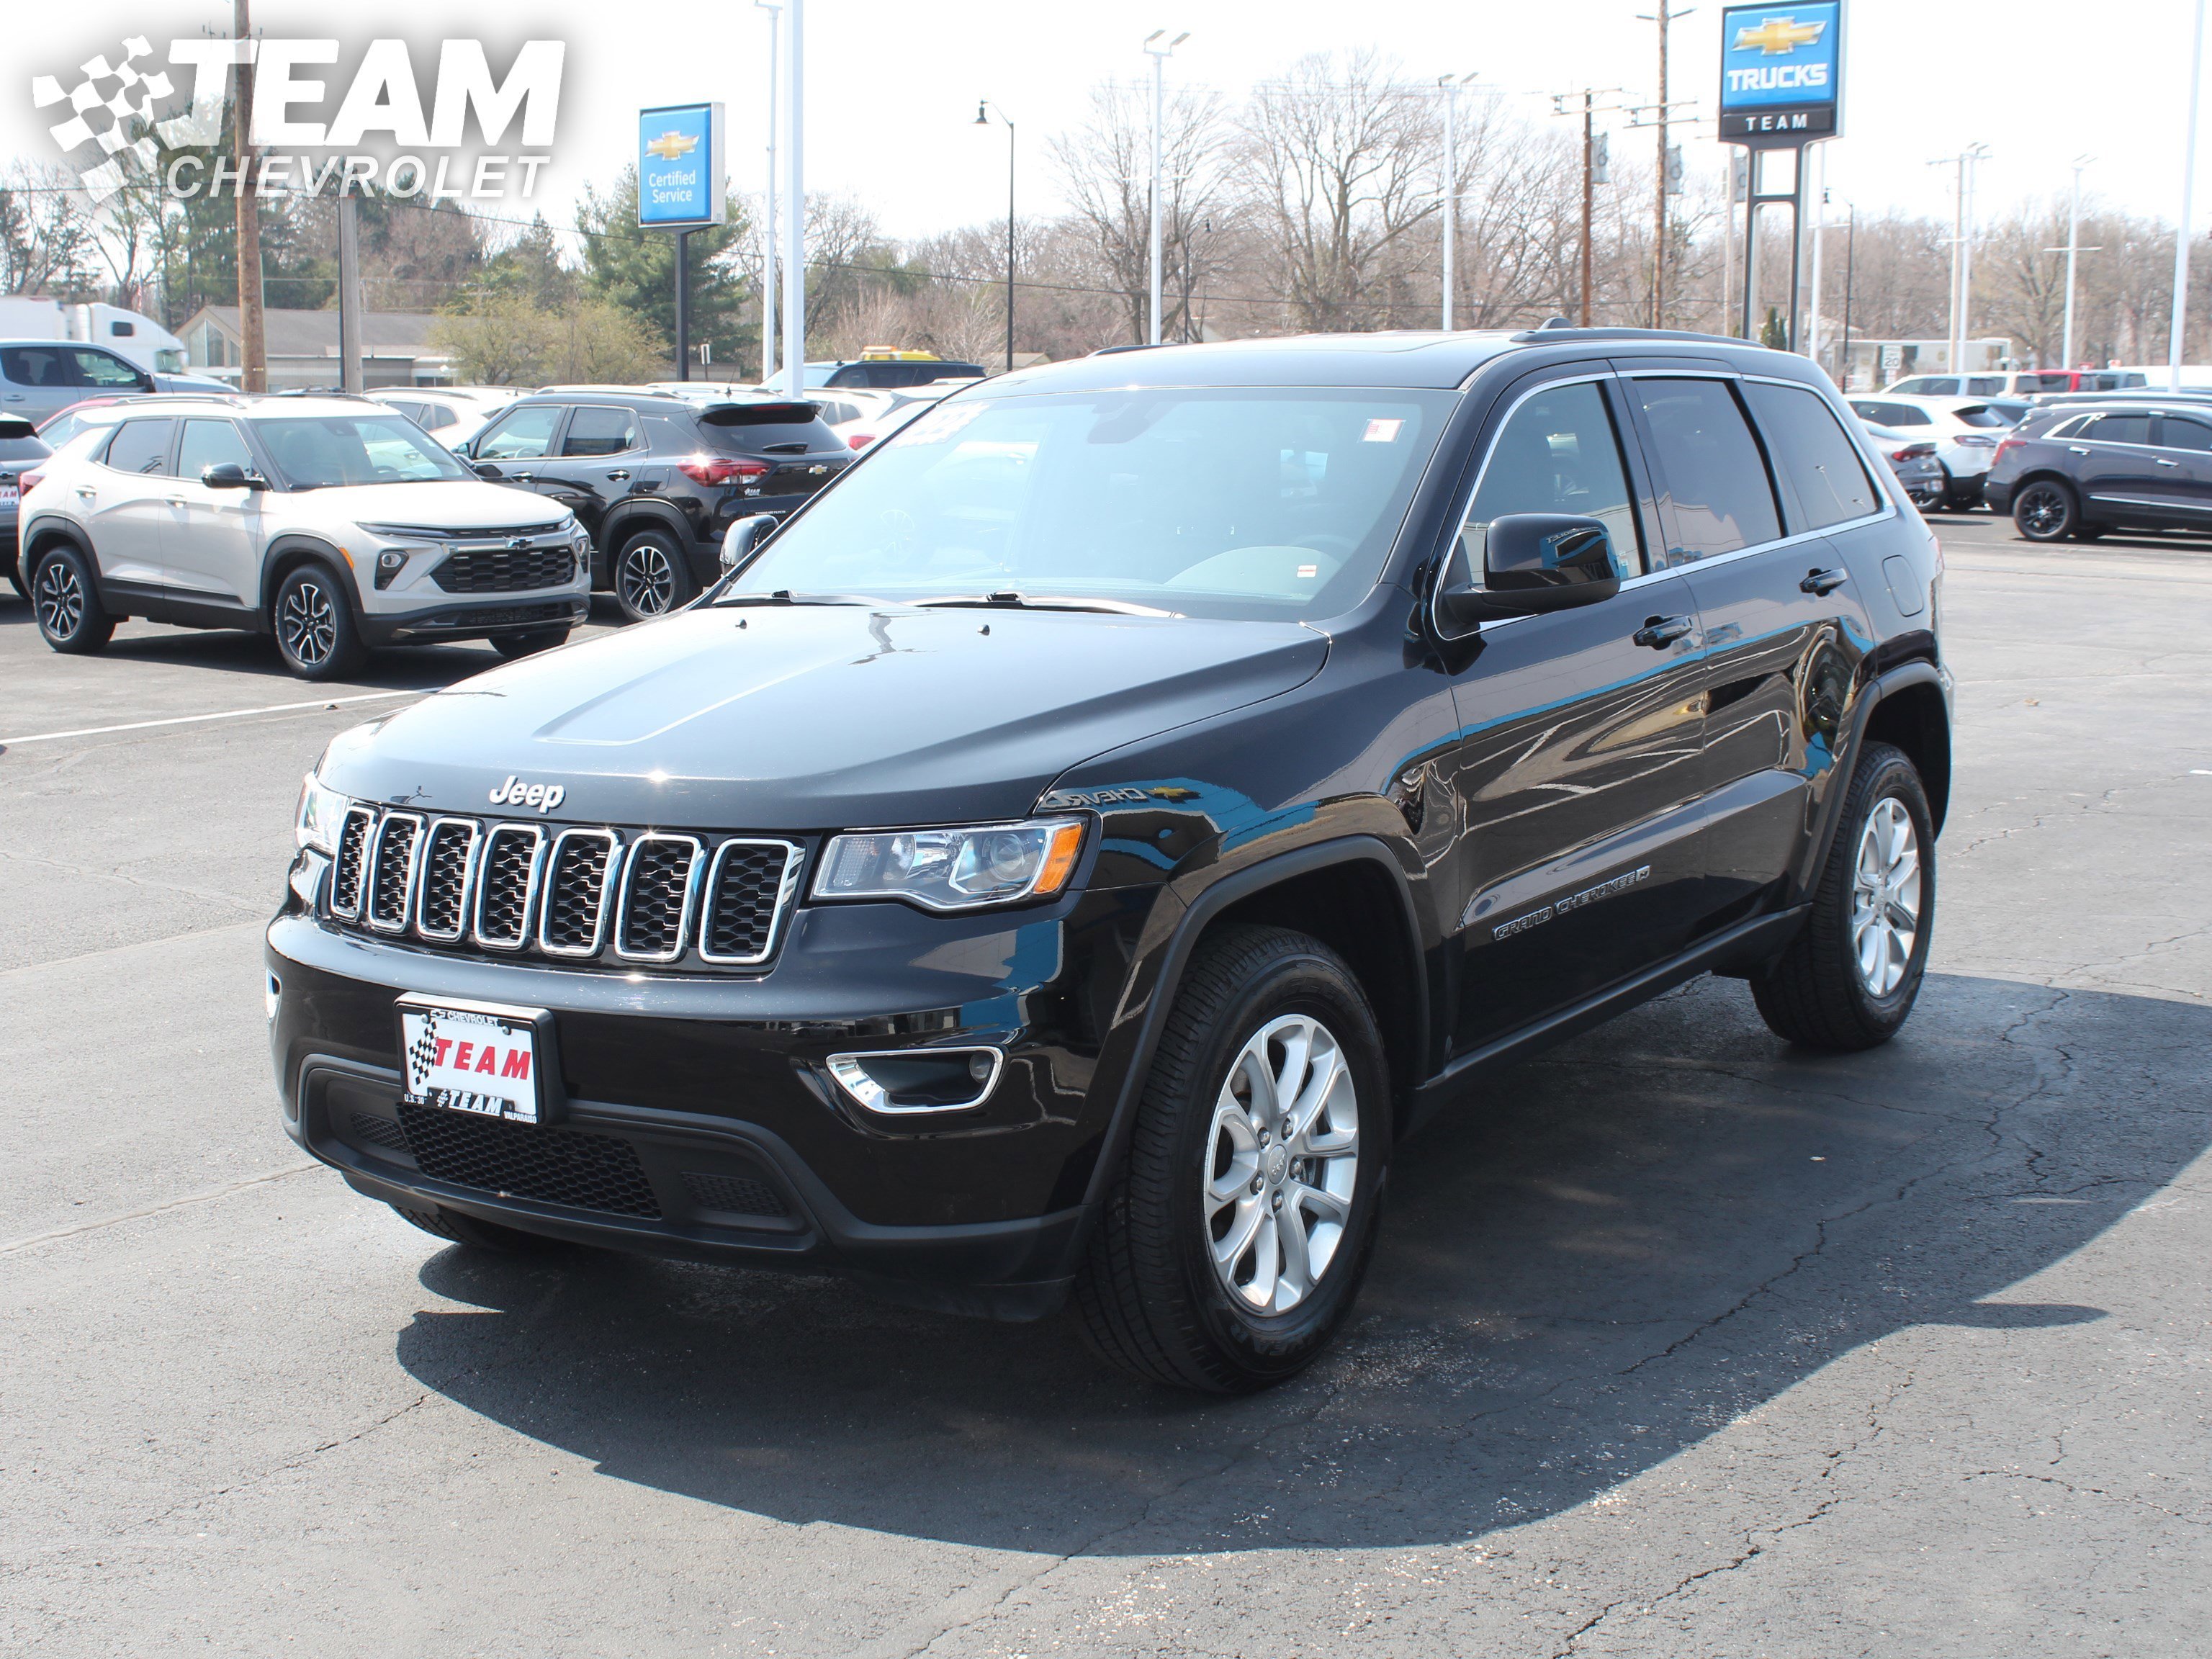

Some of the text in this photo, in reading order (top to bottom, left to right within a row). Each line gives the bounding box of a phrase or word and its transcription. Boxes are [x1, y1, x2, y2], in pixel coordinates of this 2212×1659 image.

[1727, 63, 1828, 91] TRUCKS
[1745, 114, 1808, 131] TEAM
[649, 170, 696, 187] Certified
[652, 188, 693, 204] Service
[489, 775, 566, 814] Jeep
[1492, 871, 1636, 941] GRAND CHEROKEE
[447, 1011, 499, 1026] CHEVROLET
[435, 1038, 531, 1080] TEAM
[449, 1090, 503, 1114] TEAM
[504, 1111, 537, 1125] VALPARAISO
